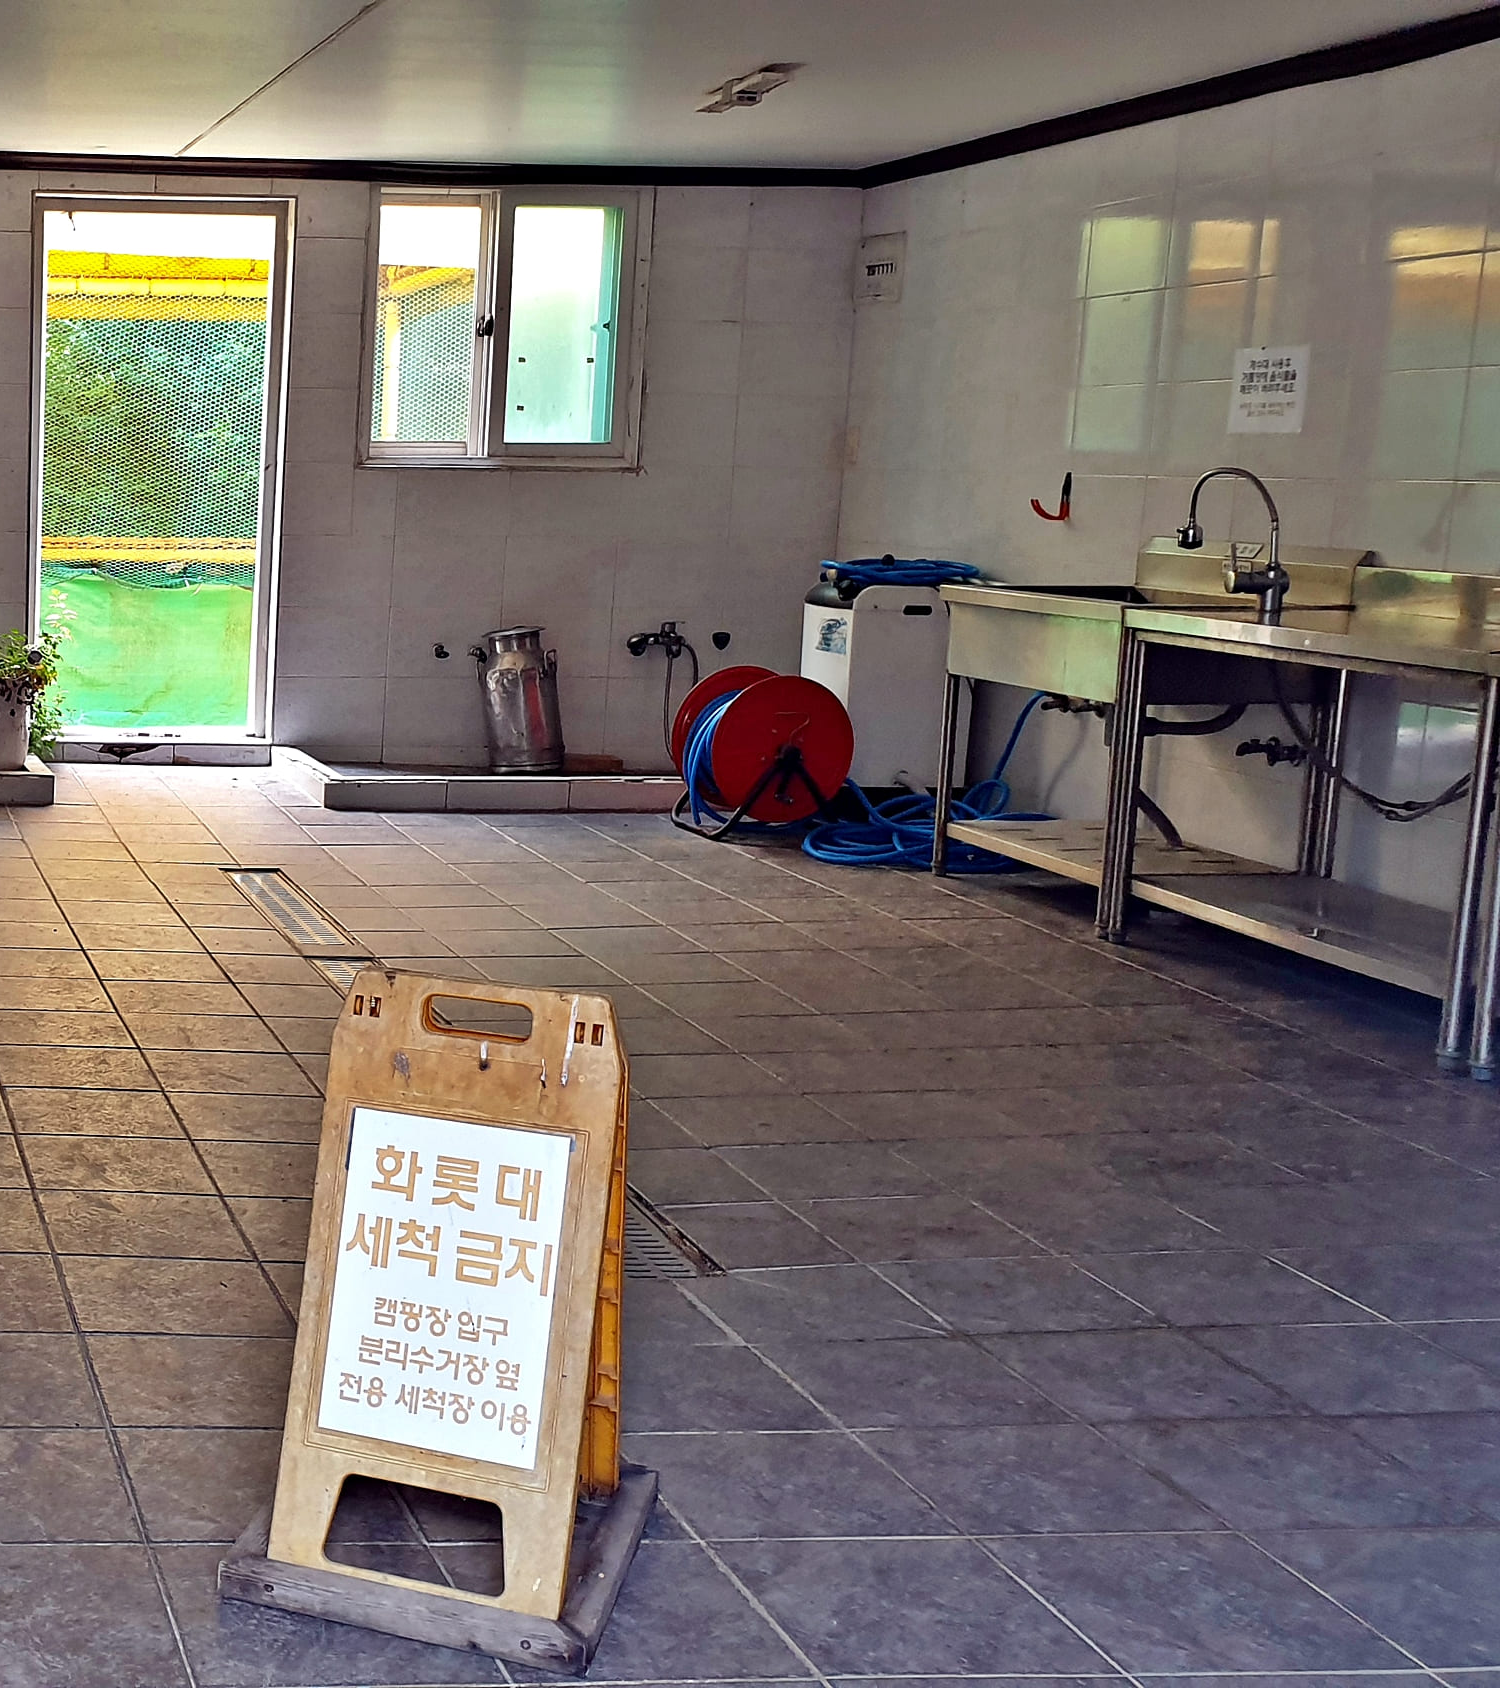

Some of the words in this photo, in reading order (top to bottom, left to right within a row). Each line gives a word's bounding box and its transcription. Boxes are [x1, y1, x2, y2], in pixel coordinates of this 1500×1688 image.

[345, 1213, 442, 1278] 세척
[455, 1229, 553, 1297] 금지
[373, 1296, 452, 1337] 캠핑장
[456, 1310, 509, 1346] 입구
[358, 1335, 490, 1386] 분리수거장
[495, 1358, 522, 1392] 옆
[338, 1372, 388, 1409] 전용
[394, 1382, 475, 1425] 세척장
[480, 1399, 533, 1437] 이용
